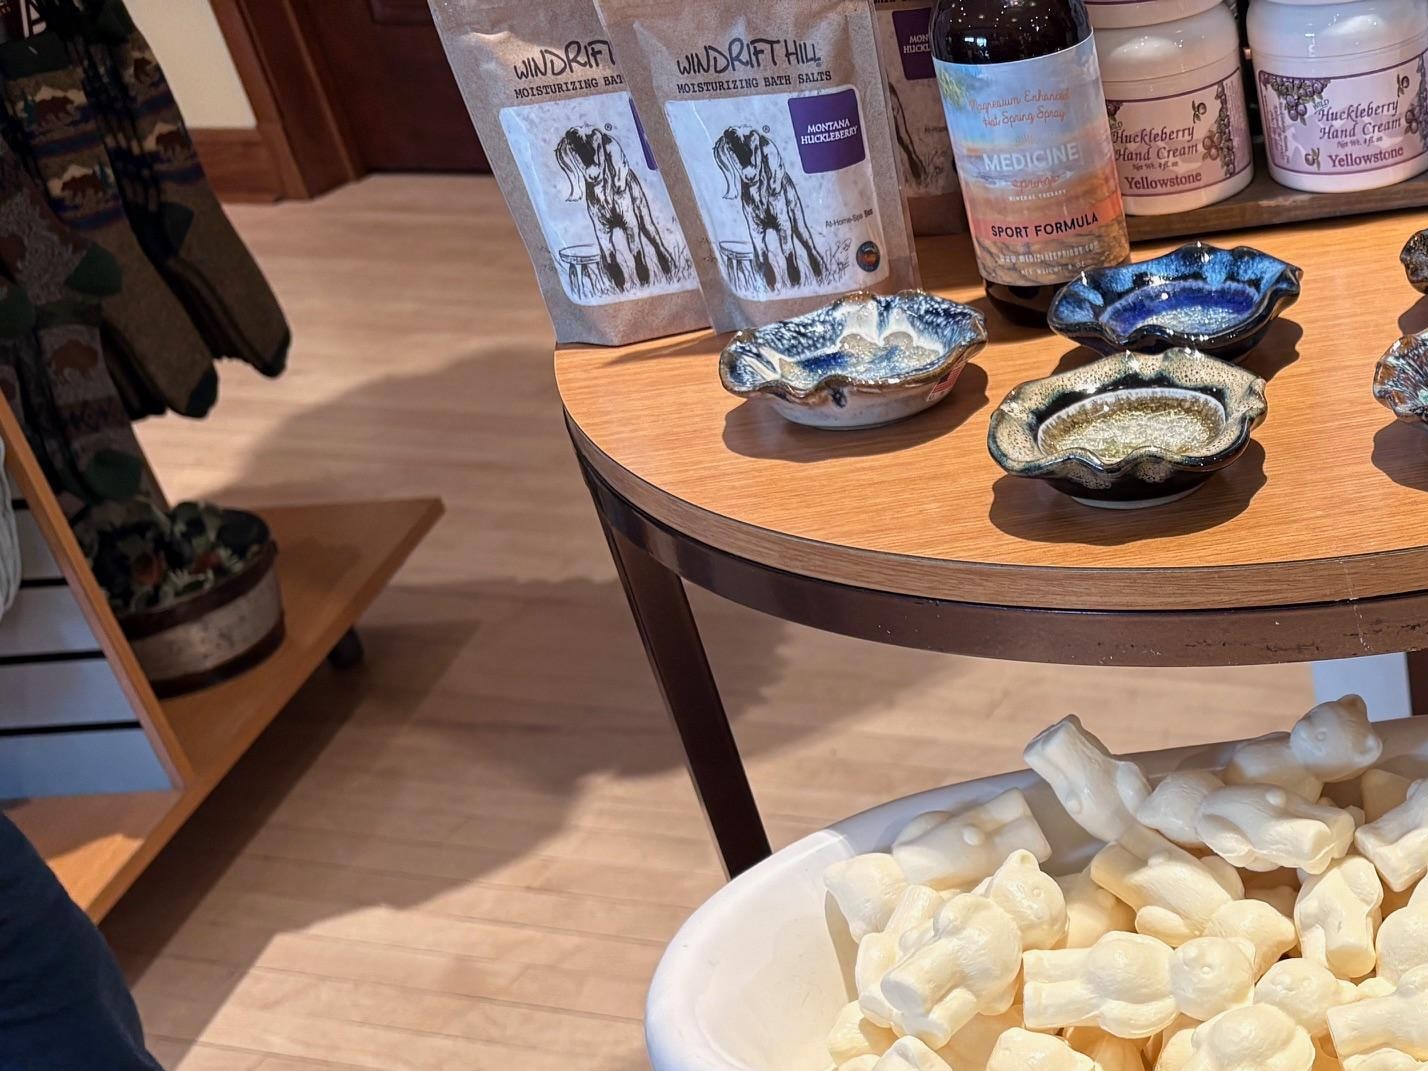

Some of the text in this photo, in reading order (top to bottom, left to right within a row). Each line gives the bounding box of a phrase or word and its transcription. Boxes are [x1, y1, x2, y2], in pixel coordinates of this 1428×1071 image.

[513, 40, 616, 80] WINDRIFT
[676, 37, 822, 76] WINDRIFT HILL
[514, 74, 624, 99] MOISTURIZING BAT
[676, 70, 832, 94] MOISTURIZING BATH SALTS
[1036, 104, 1066, 124] Spray
[1313, 99, 1399, 124] Huckleberry
[801, 126, 858, 145] HUCKLEBERRY
[807, 118, 851, 133] MONTANA
[1112, 125, 1196, 148] Huckleberry
[1319, 117, 1402, 140] Hand Cream
[982, 142, 1080, 171] MEDICINE
[1115, 142, 1200, 162] Hand Cream
[1328, 146, 1404, 168] Yellowstone
[1124, 171, 1203, 190] Yellowstone
[991, 211, 1099, 239] SPORT FORMULA
